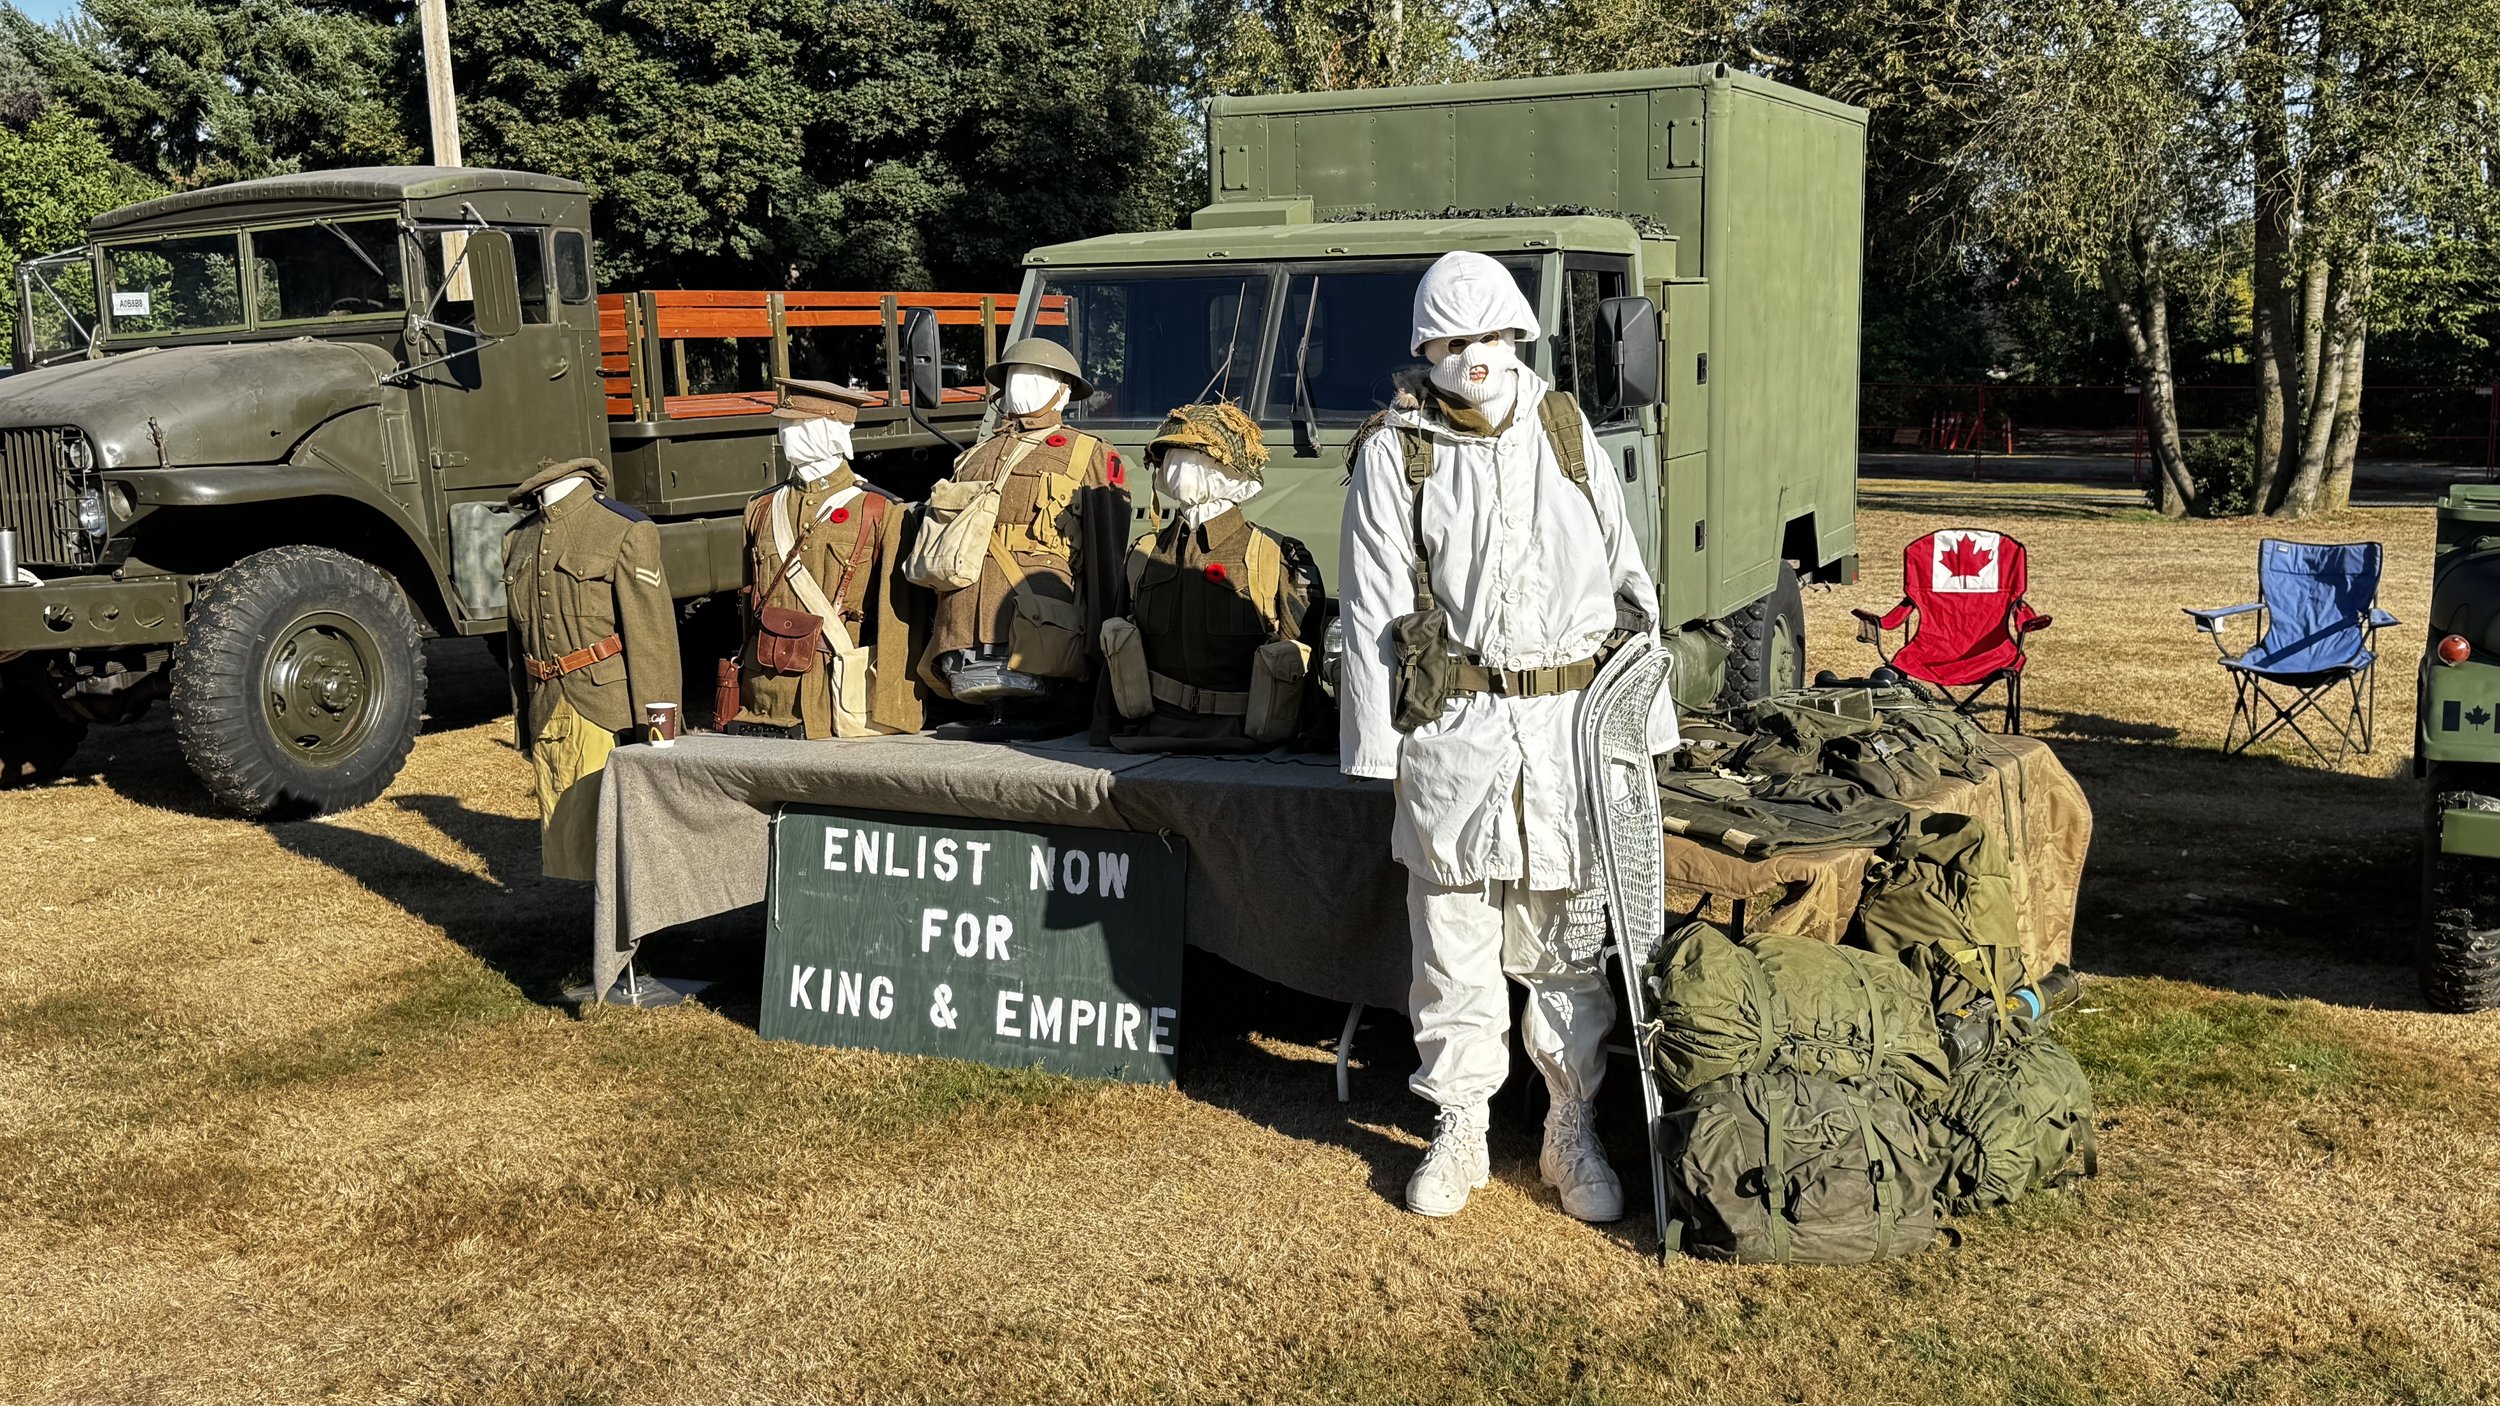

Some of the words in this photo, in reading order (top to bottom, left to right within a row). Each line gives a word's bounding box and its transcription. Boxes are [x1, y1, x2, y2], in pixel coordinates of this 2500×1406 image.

[823, 826, 991, 886] ENLIST
[1029, 844, 1130, 899] NOW
[921, 907, 1014, 961] FOR
[789, 964, 894, 1021] KING
[929, 983, 958, 1030] &
[996, 990, 1177, 1055] EMPIRE
